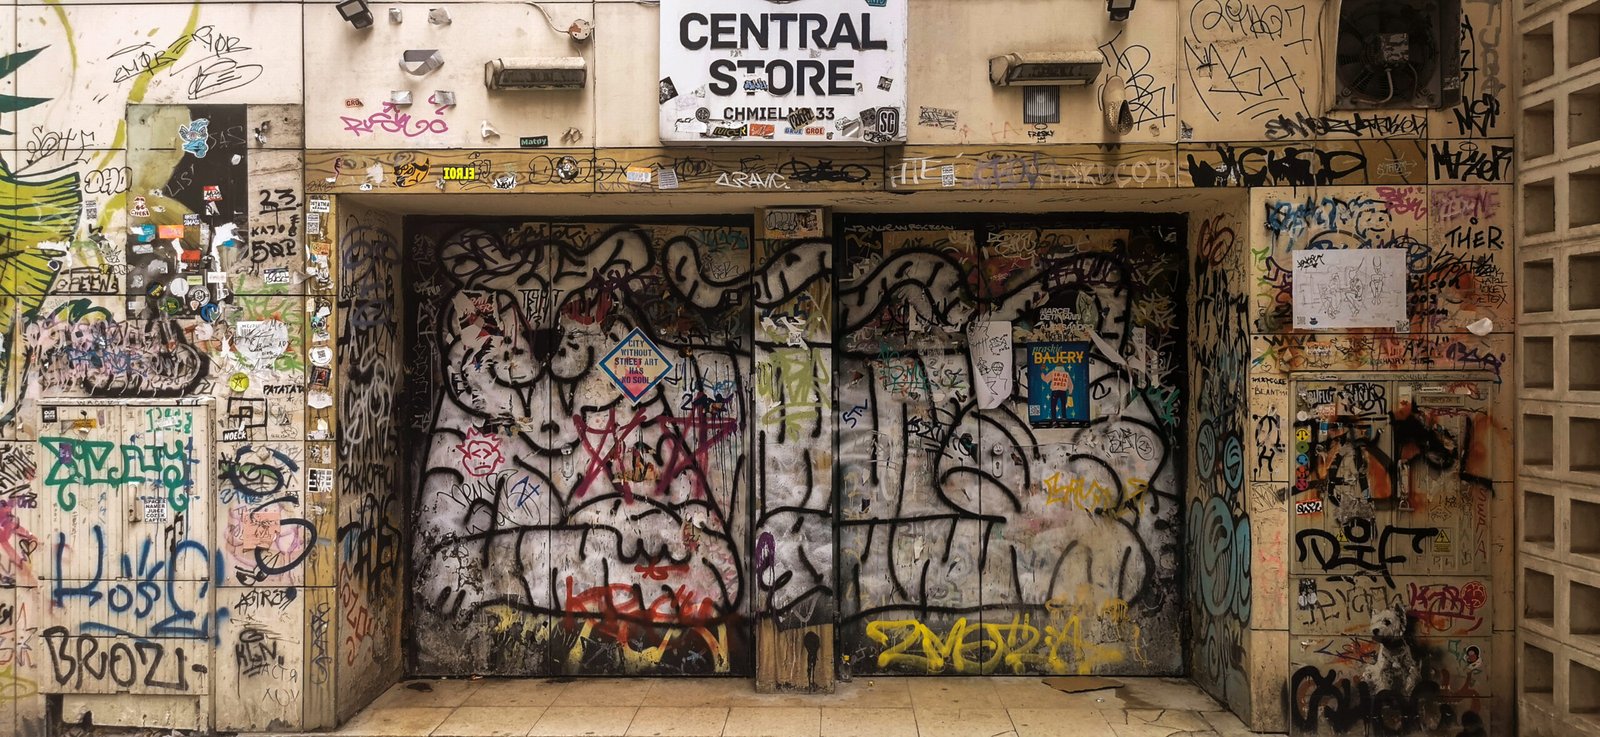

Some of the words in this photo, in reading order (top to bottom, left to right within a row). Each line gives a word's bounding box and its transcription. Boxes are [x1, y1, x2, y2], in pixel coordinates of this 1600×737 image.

[679, 13, 888, 50] CENTRAL
[709, 59, 855, 96] STORE
[723, 107, 806, 121] CHMIELN
[816, 107, 835, 120] 33
[879, 113, 896, 133] SC
[628, 339, 645, 348] CITY
[620, 349, 652, 357] WITHOUT
[1034, 351, 1084, 364] BAJERY
[614, 357, 642, 366] STREET
[644, 358, 659, 366] ART
[621, 376, 632, 384] NO
[633, 376, 650, 384] SOUL
